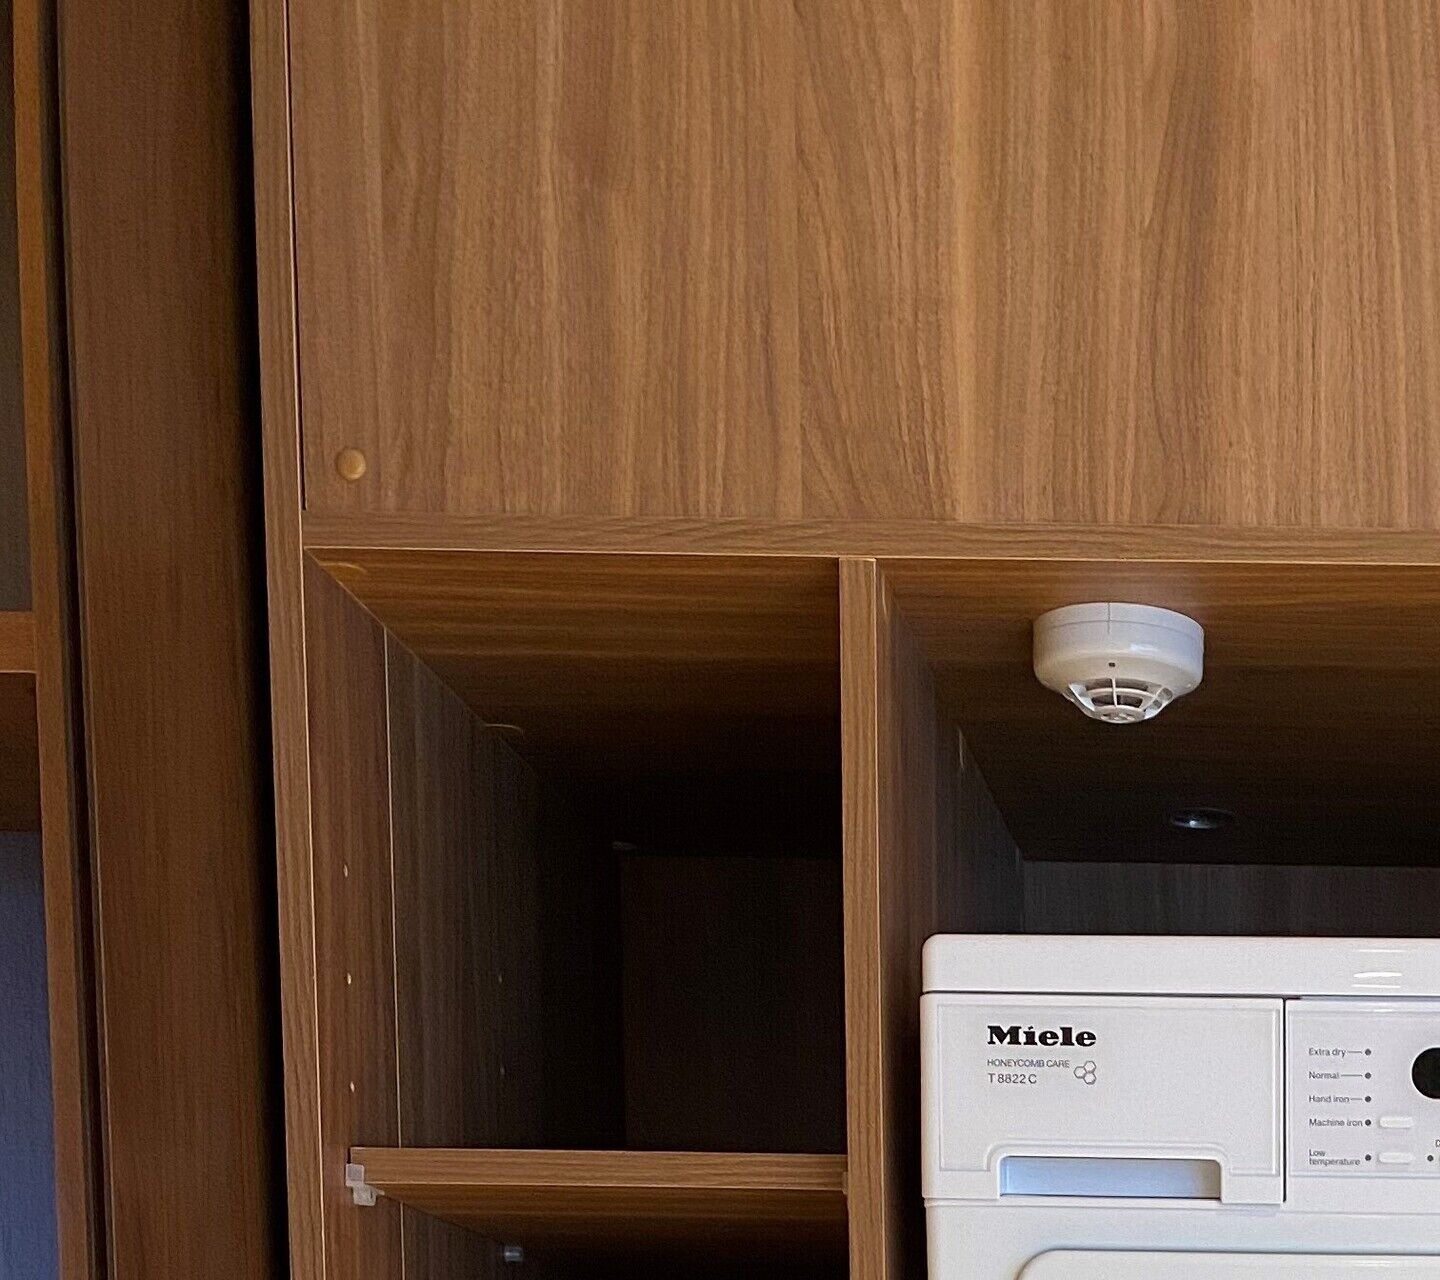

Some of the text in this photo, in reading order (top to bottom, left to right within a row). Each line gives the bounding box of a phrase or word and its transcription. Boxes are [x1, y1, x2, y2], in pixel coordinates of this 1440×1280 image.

[987, 1025, 1097, 1047] Miele
[1308, 1048, 1347, 1059] Extra dry
[987, 1059, 1071, 1068] HONEYCOMB CARE
[988, 1073, 1038, 1084] T 8822 C
[1308, 1071, 1340, 1080] Normal
[1308, 1095, 1350, 1103] Hand iron
[1309, 1118, 1363, 1127] Machine iron
[1309, 1149, 1326, 1157] Low
